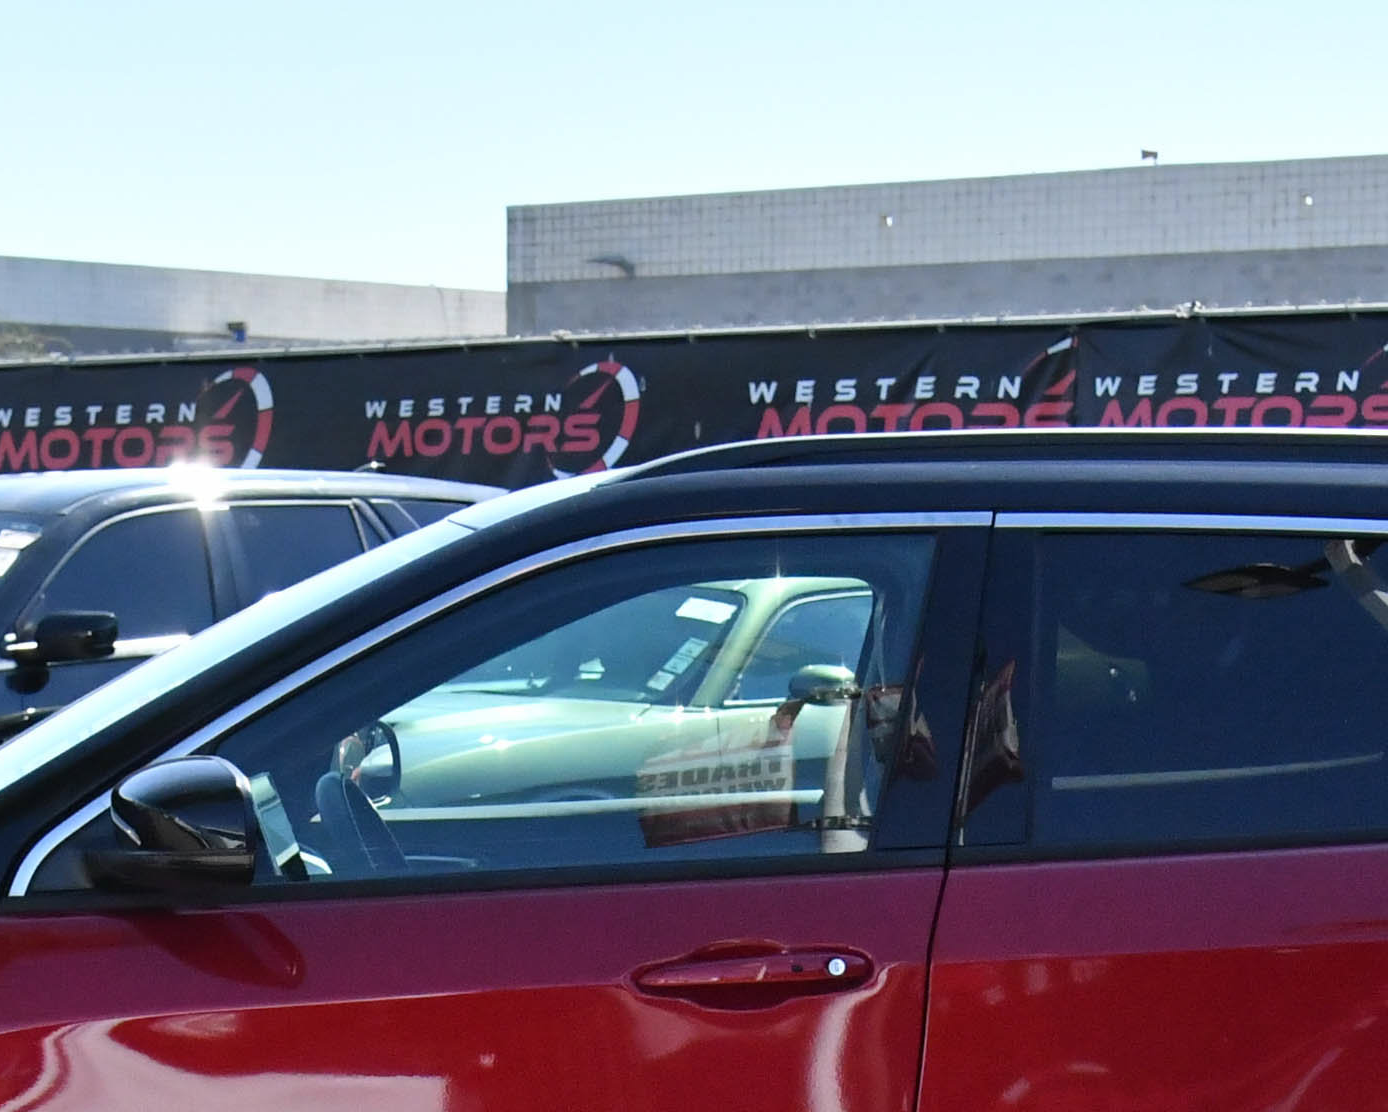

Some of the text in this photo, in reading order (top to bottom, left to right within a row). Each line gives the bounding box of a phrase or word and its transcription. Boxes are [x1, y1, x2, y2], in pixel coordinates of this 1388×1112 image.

[749, 375, 1023, 404] WESTERN
[1095, 370, 1360, 397] WESTERN
[365, 392, 563, 418] WESTERN
[755, 400, 1076, 440] MOTORS
[366, 413, 603, 459] MOTORS
